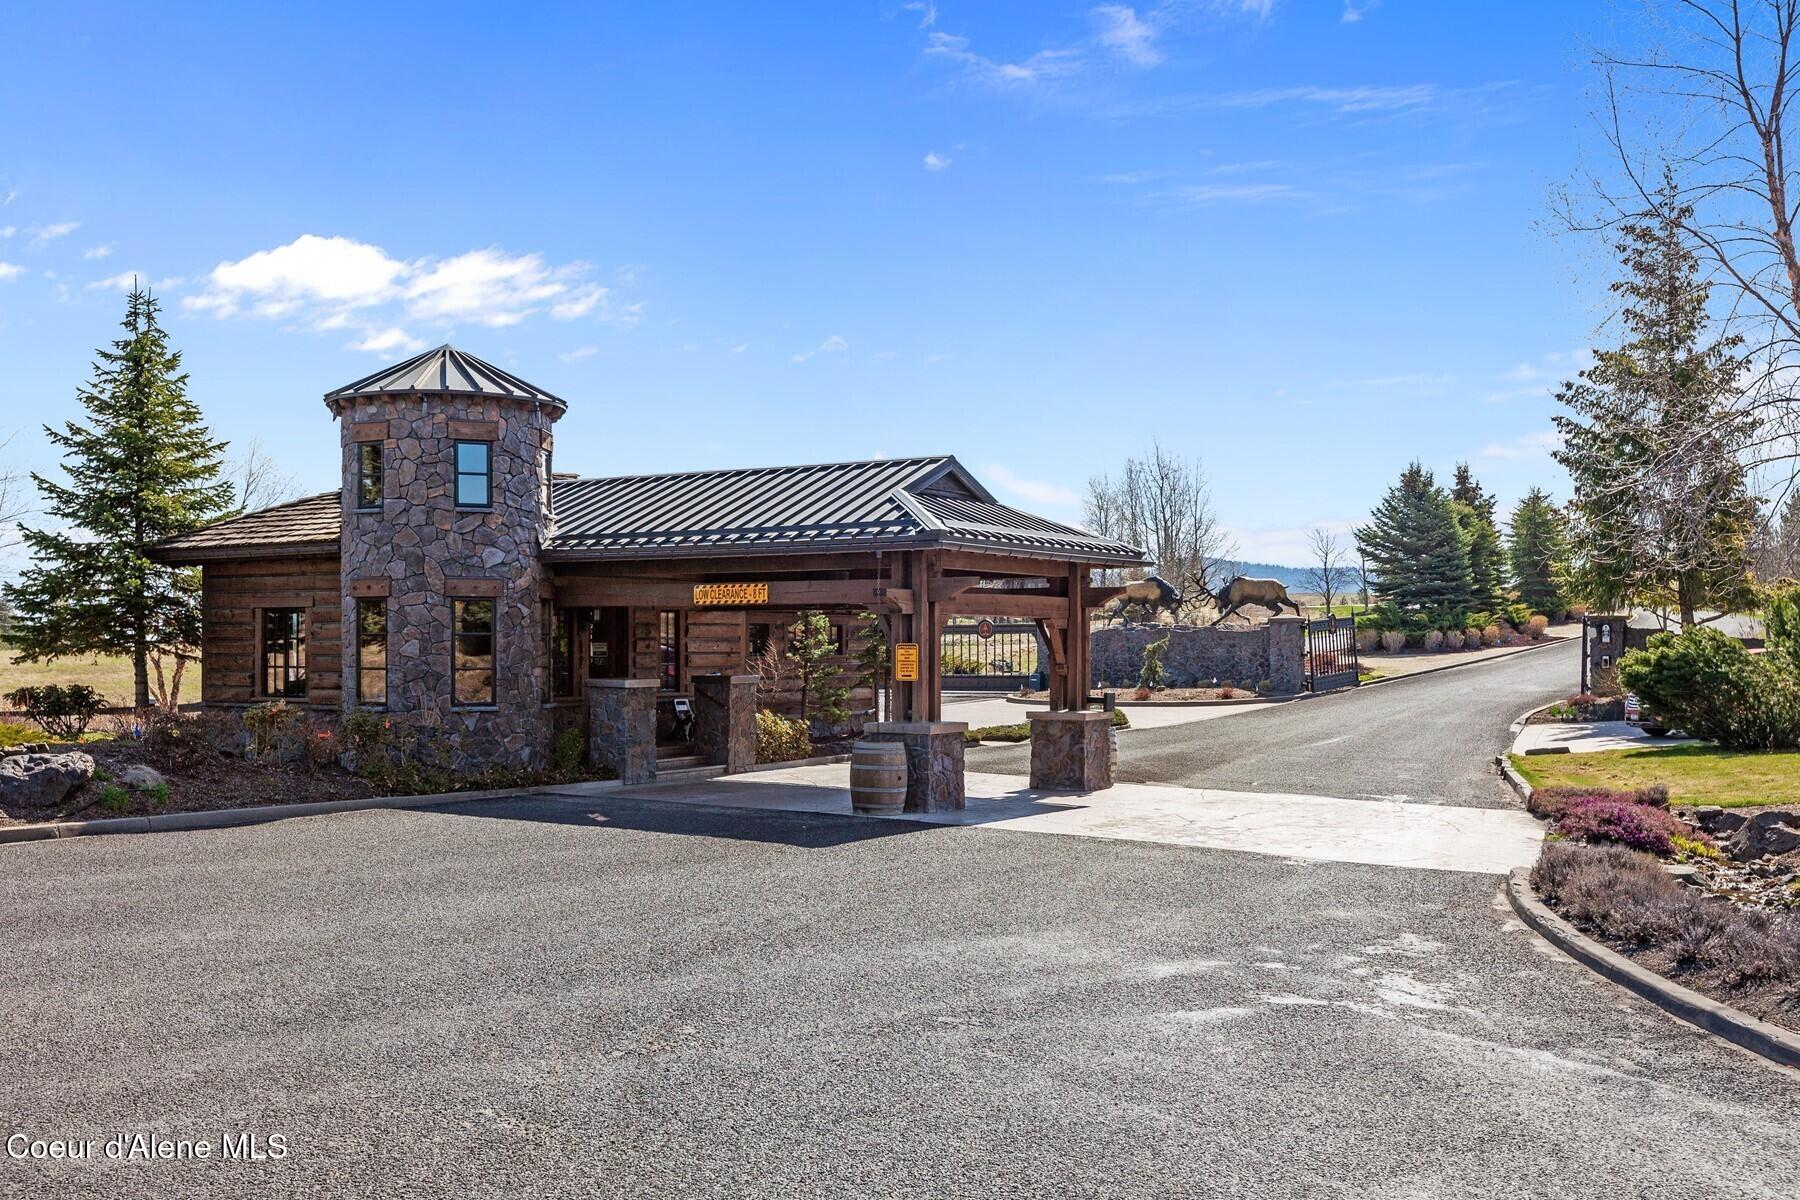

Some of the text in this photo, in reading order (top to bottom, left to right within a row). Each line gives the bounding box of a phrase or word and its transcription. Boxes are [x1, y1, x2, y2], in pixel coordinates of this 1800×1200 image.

[695, 589, 709, 600] LOW
[710, 588, 748, 600] CLEARANCE
[753, 588, 758, 599] 8
[759, 587, 766, 599] FT
